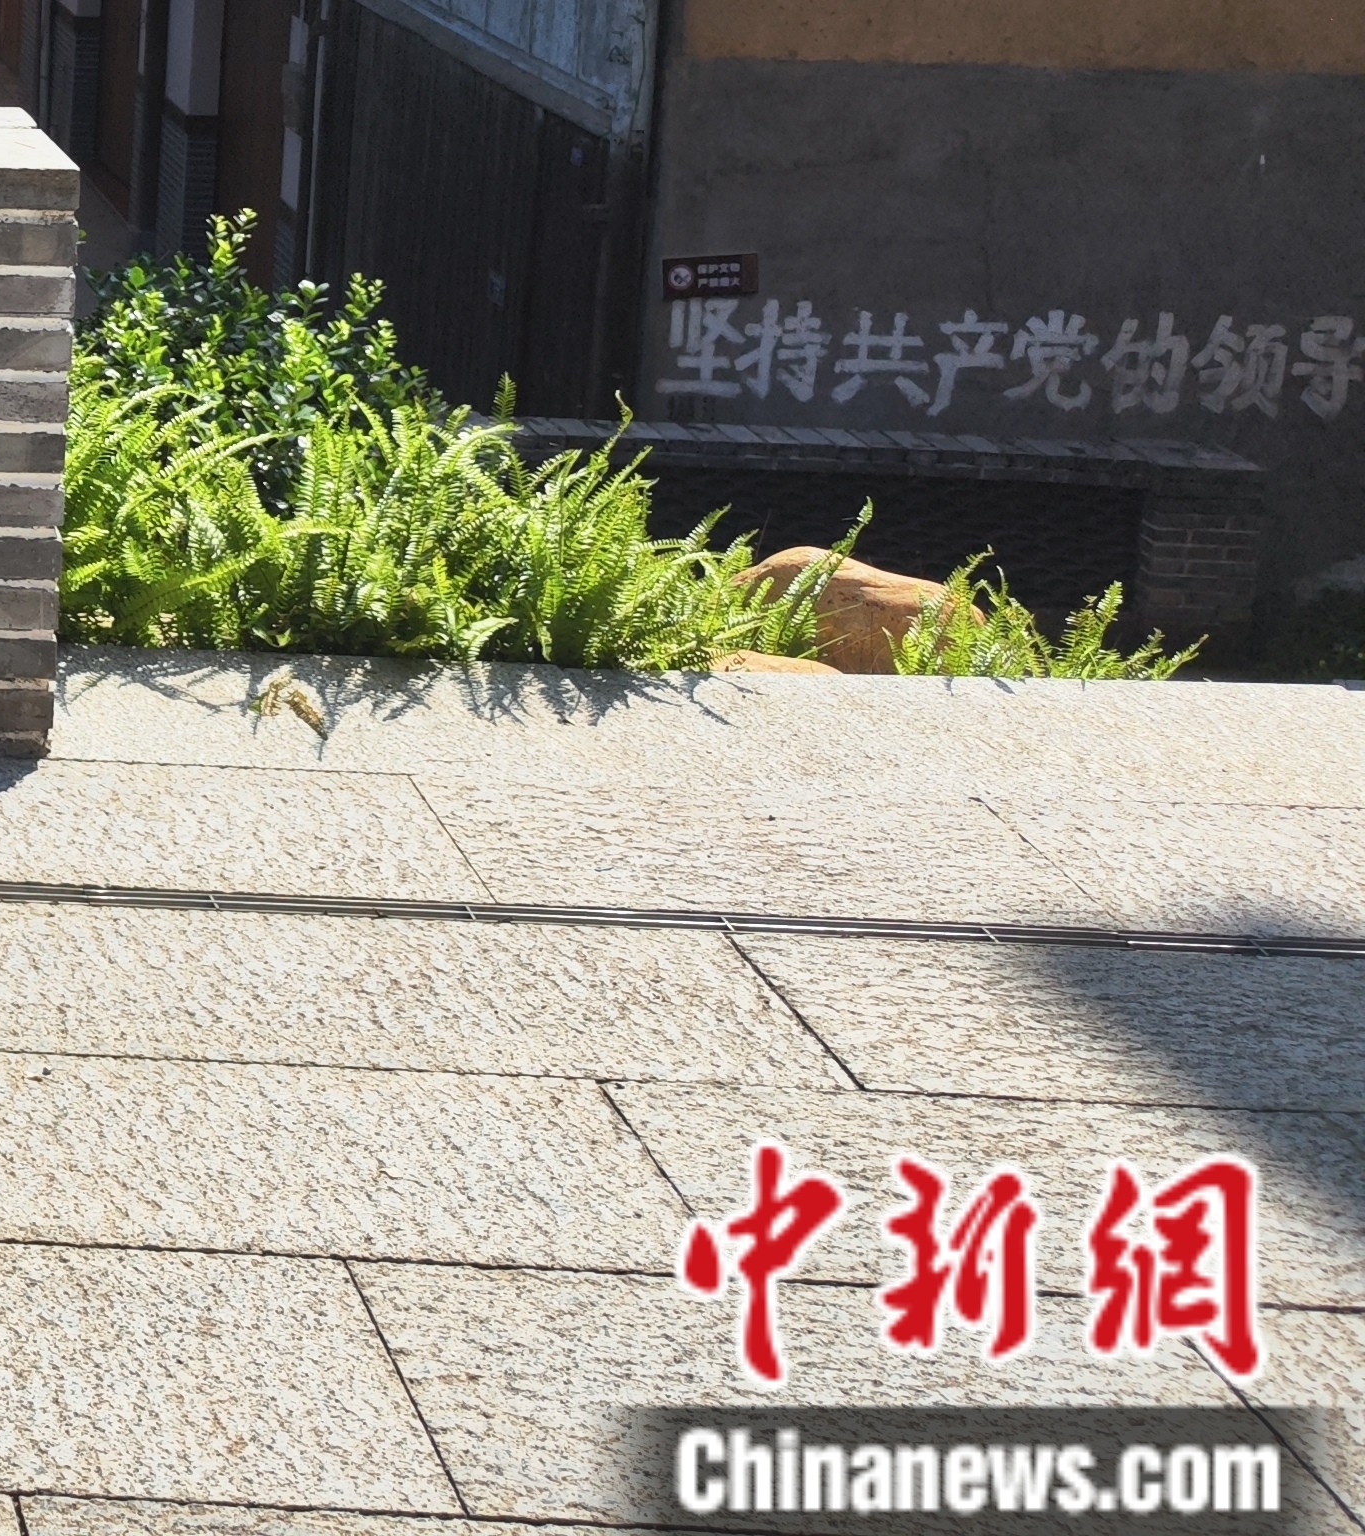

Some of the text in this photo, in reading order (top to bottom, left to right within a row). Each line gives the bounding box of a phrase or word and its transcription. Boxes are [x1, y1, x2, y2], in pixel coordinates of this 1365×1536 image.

[656, 298, 1365, 419] 坚持共产党的领导
